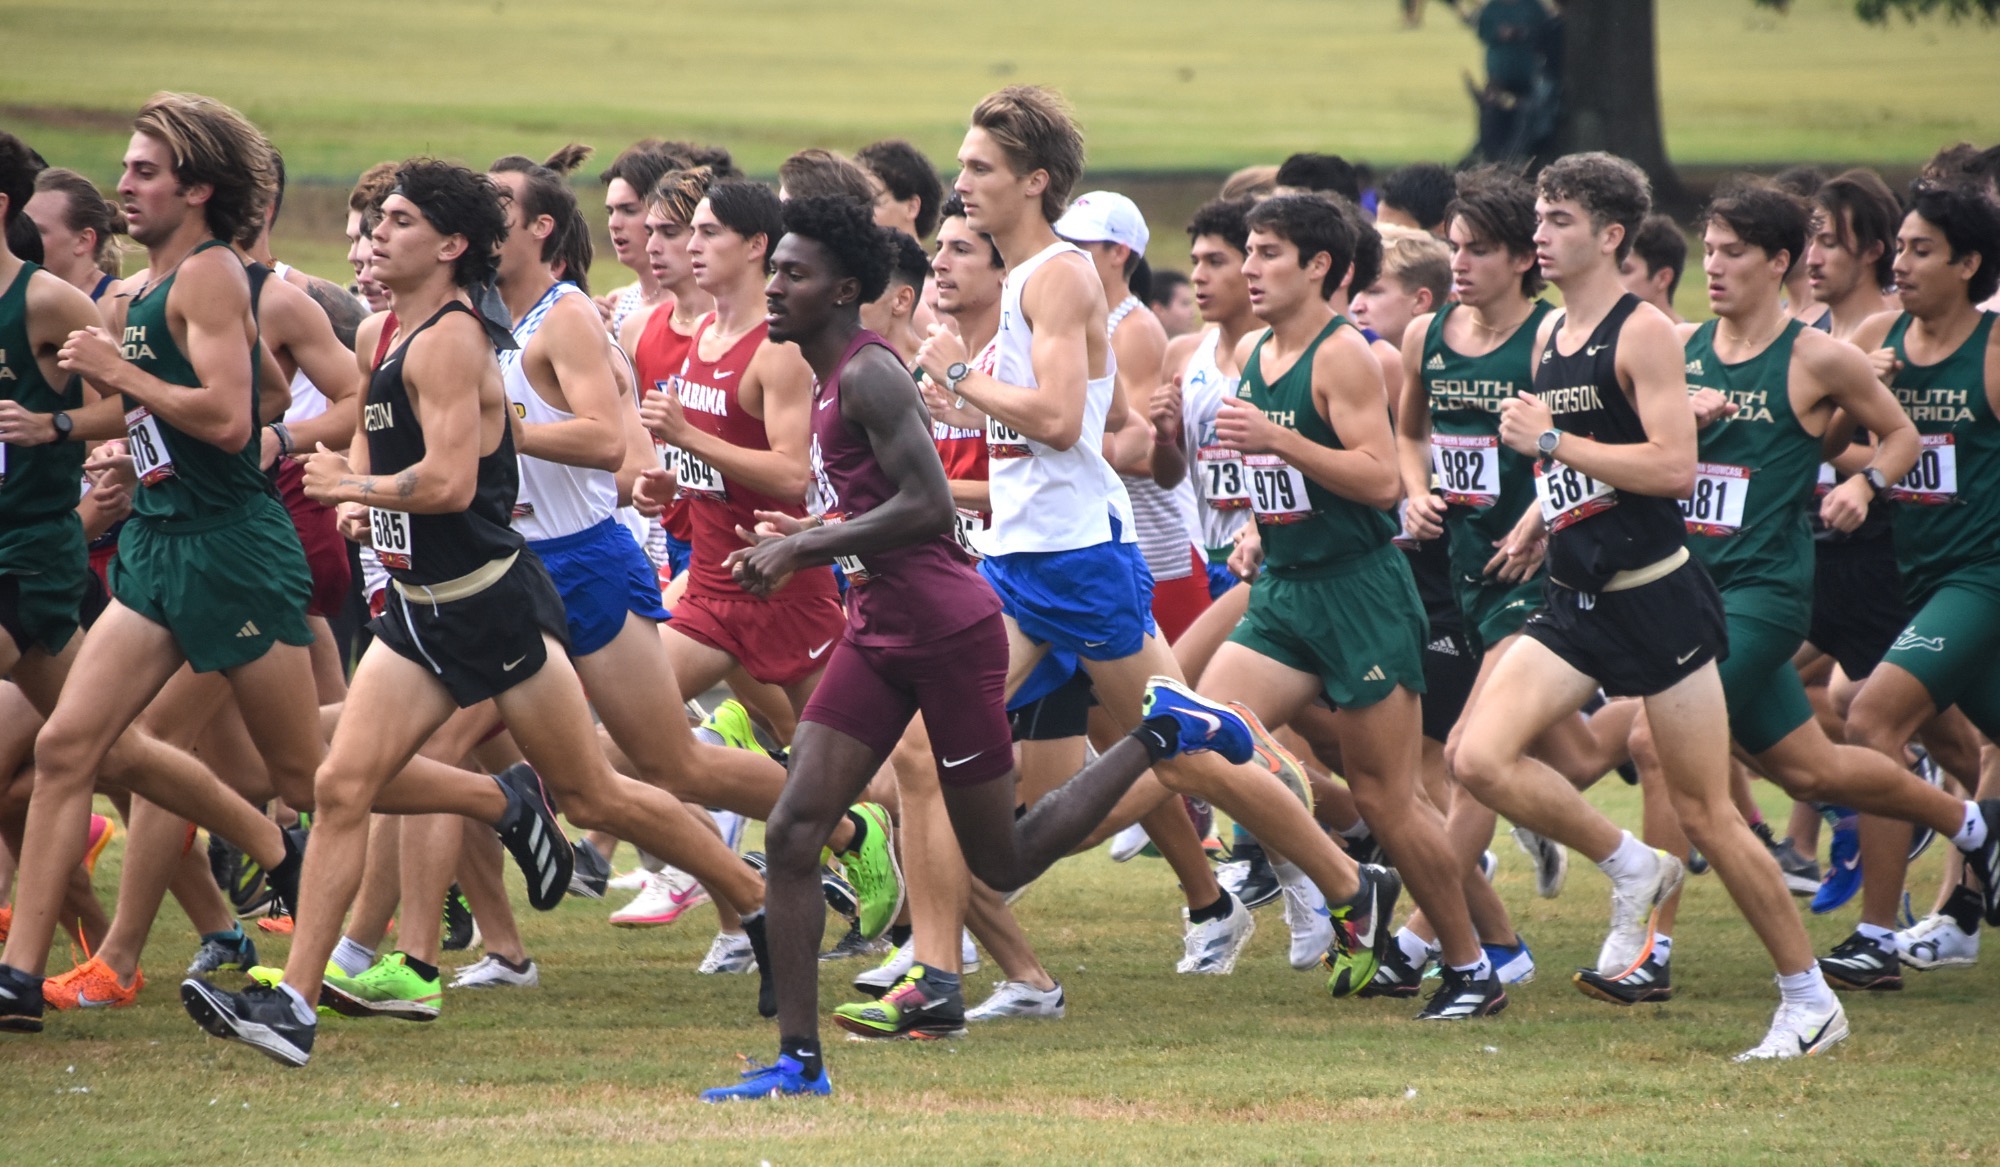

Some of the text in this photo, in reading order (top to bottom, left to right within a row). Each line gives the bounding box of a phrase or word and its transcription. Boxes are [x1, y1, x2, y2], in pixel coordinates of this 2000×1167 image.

[678, 378, 728, 417] LABAMA
[1431, 380, 1513, 396] SOUTH
[1890, 387, 1968, 405] OUTH
[1442, 449, 1486, 491] 982
[1707, 464, 1743, 478] SHOWCASE
[1897, 450, 1941, 490] 80
[1254, 469, 1297, 511] 979
[373, 509, 406, 550] 585
[1427, 644, 1460, 657] adidas
